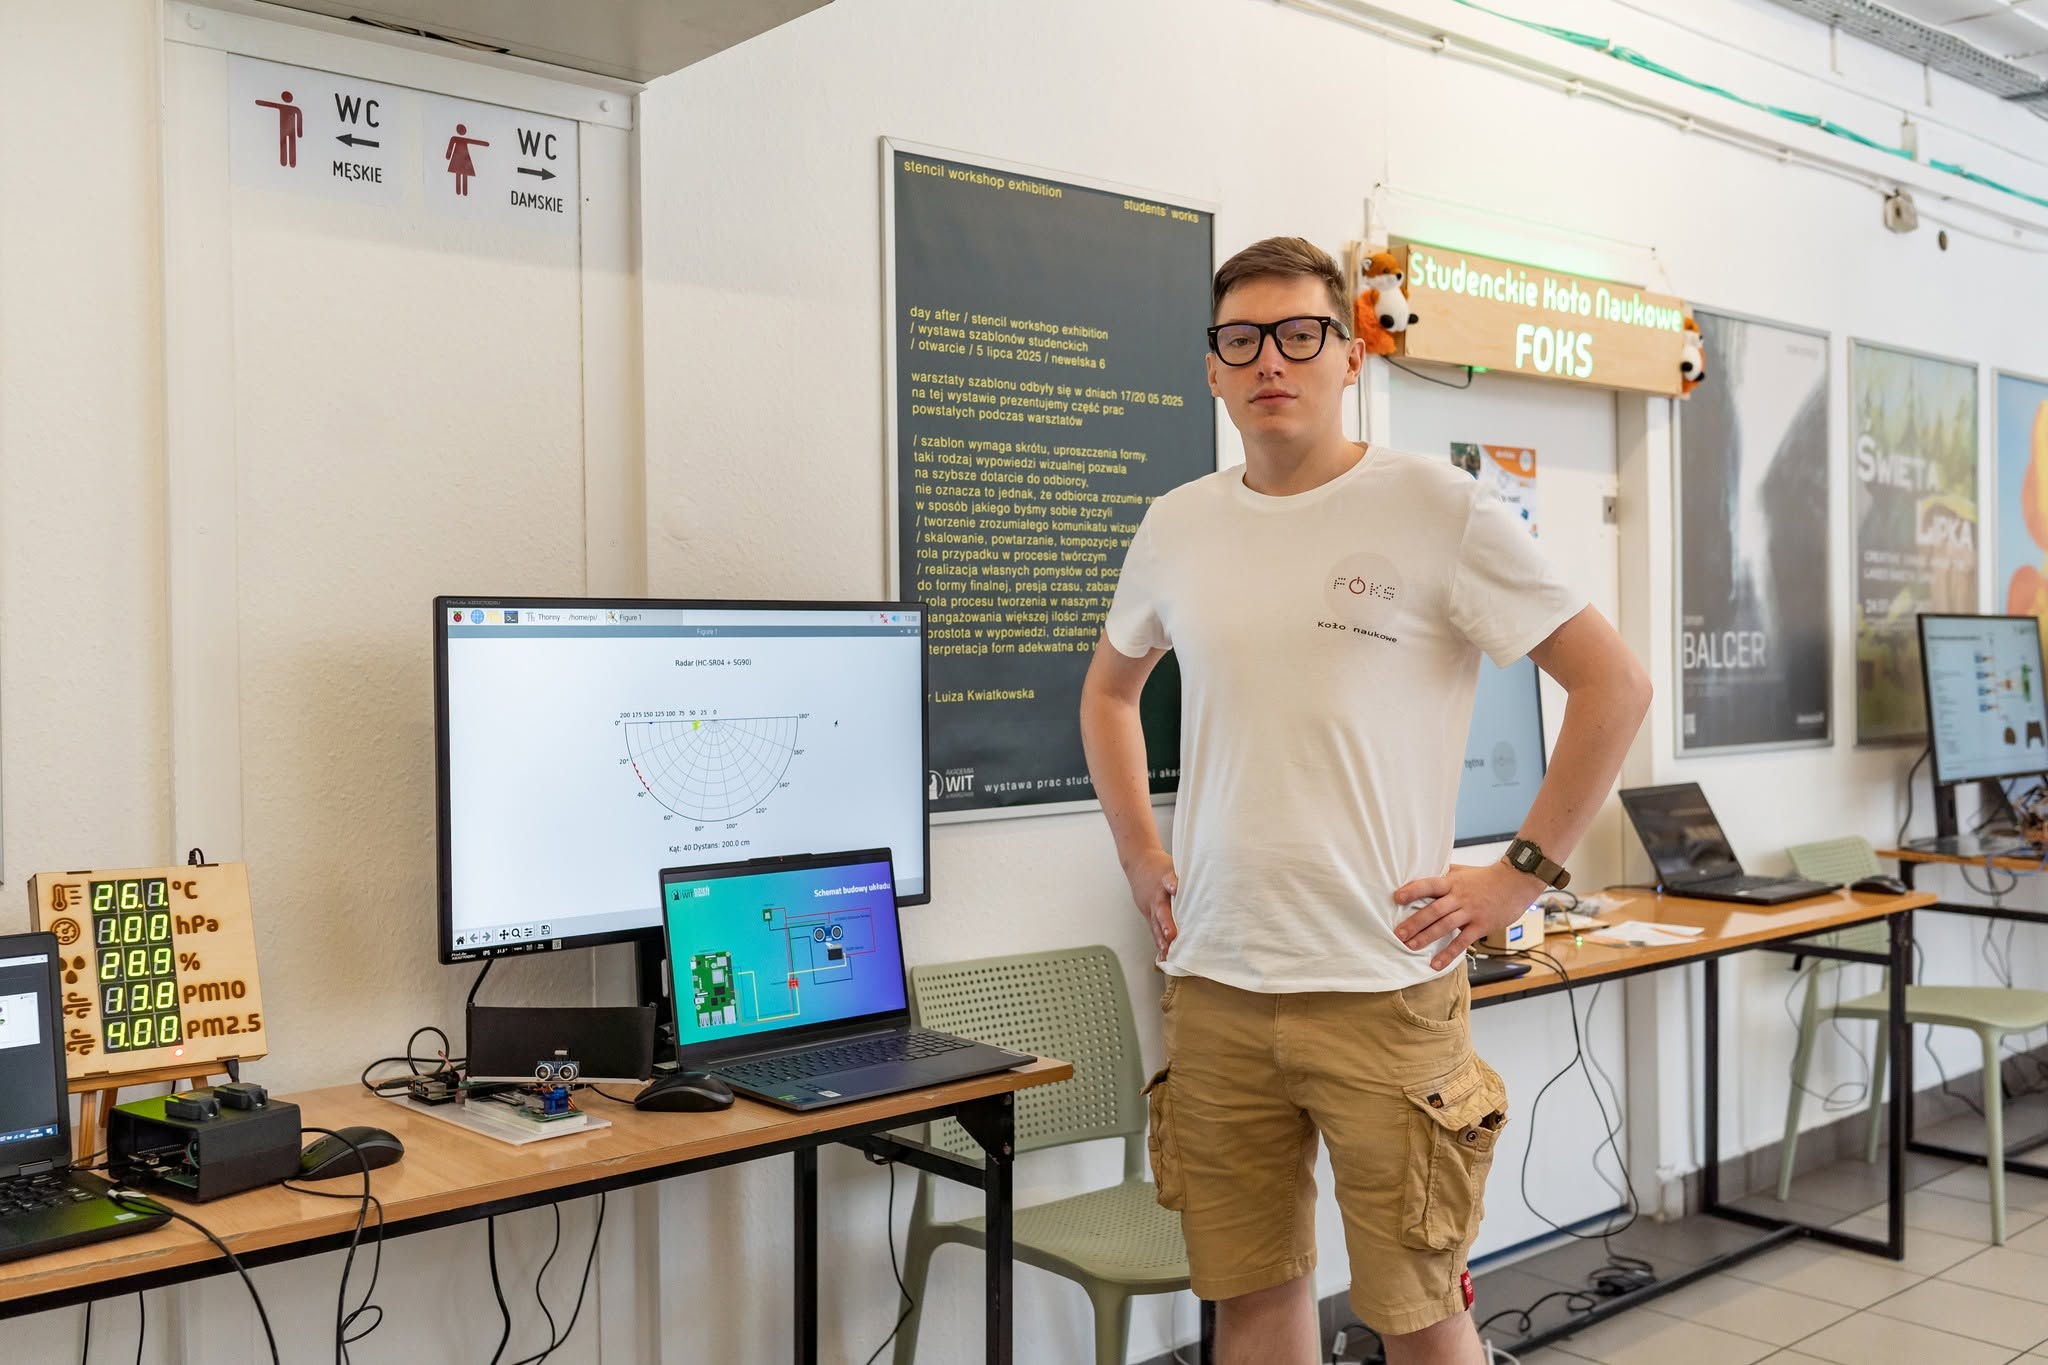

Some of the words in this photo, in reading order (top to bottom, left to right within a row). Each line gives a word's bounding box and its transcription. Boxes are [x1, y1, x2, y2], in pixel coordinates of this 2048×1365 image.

[335, 93, 380, 128] WC
[517, 128, 557, 160] WC
[333, 161, 382, 183] MĘSKIE
[904, 160, 944, 177] stencil
[949, 169, 1004, 189] workshop
[1009, 178, 1062, 198] exhibition
[510, 191, 563, 214] DAMSKIE
[1171, 209, 1199, 223] works
[1410, 252, 1538, 307] Studenckie
[1543, 278, 1591, 316] Koło
[1596, 288, 1683, 333] Naukowe
[910, 307, 931, 321] day
[935, 309, 959, 322] after
[971, 314, 1007, 327] stencil
[1010, 320, 1058, 335] workshop
[1062, 325, 1108, 340] exhibition
[918, 325, 965, 340] wystawa
[969, 330, 1025, 345] szablonów
[1028, 335, 1088, 352] studenckich
[919, 341, 965, 354] otwarcie
[977, 346, 983, 356] 5
[987, 346, 1013, 360] lipca
[1016, 349, 1041, 363] 2025
[1051, 354, 1096, 368] newelska
[1099, 359, 1105, 369] 6
[1516, 323, 1593, 379] FOKS
[911, 372, 964, 388] warsztaty
[968, 377, 1016, 390] szablonu
[1020, 381, 1054, 397] odbyły
[1057, 385, 1071, 398] się
[1086, 387, 1117, 400] dniach
[1121, 390, 1145, 403] 17/20
[1148, 393, 1159, 404] 05
[1162, 394, 1183, 406] 2025
[912, 389, 925, 398] na
[929, 388, 943, 401] tej
[947, 390, 996, 406] wystawie
[1000, 396, 1068, 413] prezentujemy
[1103, 404, 1124, 417] prac
[912, 404, 975, 419] powstałych
[979, 408, 1023, 423] podczas
[1027, 412, 1083, 427] warsztatów
[921, 437, 964, 449] szablon
[968, 440, 1011, 454] wymaga
[1054, 445, 1117, 460] uproszczenia
[914, 452, 934, 463] taki
[938, 453, 972, 468] rodzaj
[976, 456, 1036, 471] wypowiedzi
[1039, 459, 1085, 473] wizualnej
[1088, 463, 1127, 475] pozwala
[915, 470, 928, 479] na
[932, 468, 976, 483] szybsze
[980, 471, 1023, 483] dotarcie
[1027, 473, 1040, 484] do
[915, 485, 932, 495] nie
[935, 487, 980, 496] oznacza
[984, 488, 995, 497] to
[1040, 490, 1052, 500] że
[1055, 491, 1098, 502] odbiorca
[1102, 493, 1142, 504] zrozumie
[928, 501, 967, 514] sposób
[972, 502, 1010, 516] jakiego
[1014, 503, 1046, 517] byśmy
[1050, 505, 1077, 516] sobie
[1080, 507, 1112, 518] życzyli
[924, 517, 975, 528] tworzenie
[980, 518, 1048, 532] zrozumiałego
[1052, 519, 1107, 532] komunikatu
[1060, 536, 1117, 549] kompozycje
[917, 548, 938, 559] rola
[942, 549, 998, 563] przypadku
[1014, 550, 1057, 563] procesie
[1061, 551, 1107, 563] twórczym
[925, 564, 978, 578] realizacja
[981, 564, 1029, 579] własnych
[1033, 565, 1082, 580] pomysłów
[1085, 566, 1098, 577] od
[918, 580, 932, 591] do
[936, 580, 966, 594] formy
[1016, 581, 1047, 593] presja
[926, 596, 946, 607] rola
[951, 596, 993, 609] procesu
[997, 596, 1046, 607] tworzenia
[1062, 598, 1098, 609] naszym
[620, 613, 636, 622] Figure
[1006, 611, 1049, 625] większej
[1053, 612, 1078, 622] ilości
[1053, 626, 1096, 637] działanie
[1318, 621, 1346, 630] Koło
[1354, 627, 1397, 643] naukowe
[992, 642, 1014, 653] form
[1018, 642, 1073, 653] adekwatna
[1077, 642, 1089, 652] do
[1683, 631, 1766, 669] BALCER
[936, 690, 963, 703] Luiza
[967, 689, 1034, 701] Kwiatkowska
[945, 775, 974, 792] WIT
[985, 781, 1032, 794] wystawa
[1037, 780, 1061, 790] prac
[693, 842, 720, 852] Dystans:
[722, 840, 739, 848] 200.0
[172, 881, 198, 899] °C
[814, 888, 842, 897] Schemat
[843, 886, 867, 894] budowy
[869, 883, 890, 891] układu
[176, 915, 218, 934] hPa
[101, 948, 171, 980] 28.9
[180, 952, 200, 971] %
[183, 981, 245, 1004] PM10
[187, 1014, 261, 1039] PM2.5
